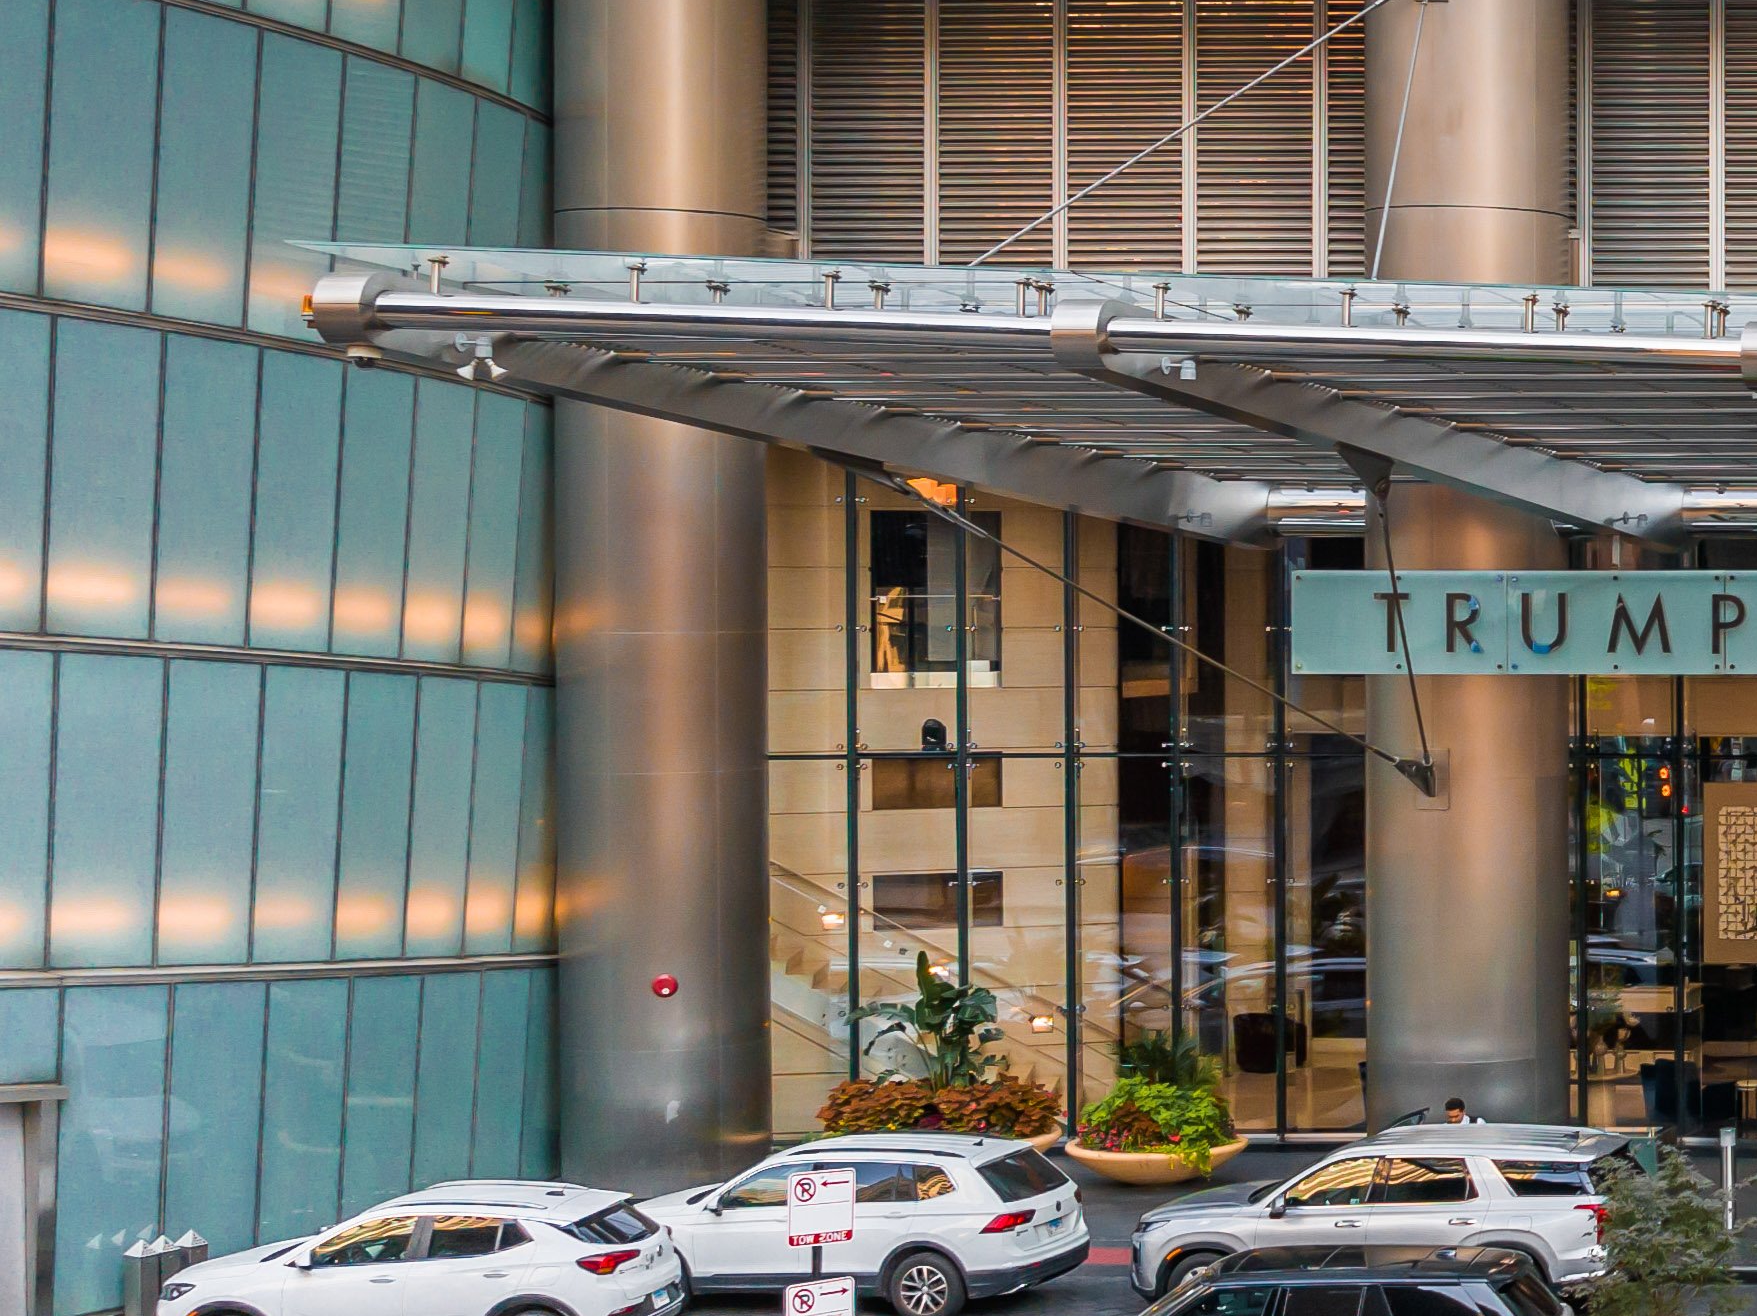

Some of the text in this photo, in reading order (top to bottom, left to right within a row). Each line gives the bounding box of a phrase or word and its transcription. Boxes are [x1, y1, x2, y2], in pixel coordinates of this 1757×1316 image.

[1373, 591, 1747, 656] TRUMP
[792, 1230, 848, 1246] TOW ZONE
